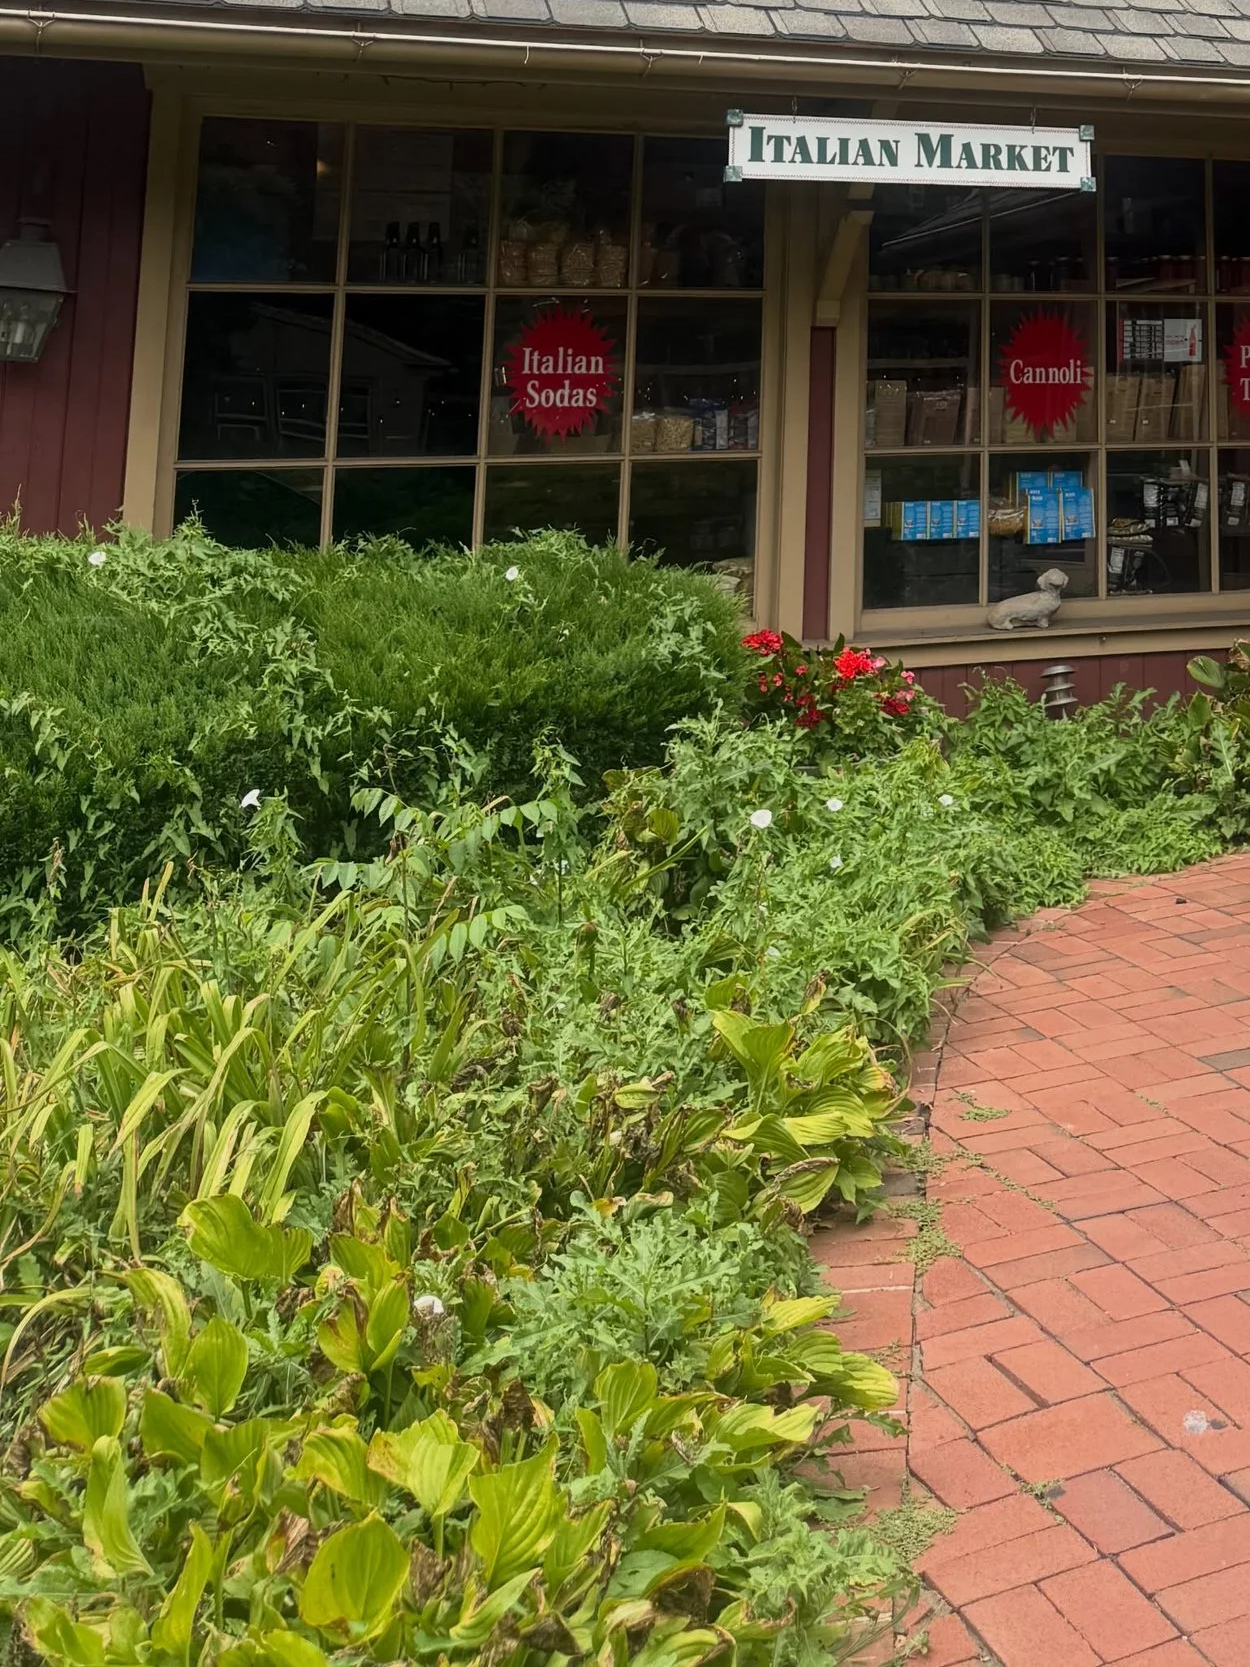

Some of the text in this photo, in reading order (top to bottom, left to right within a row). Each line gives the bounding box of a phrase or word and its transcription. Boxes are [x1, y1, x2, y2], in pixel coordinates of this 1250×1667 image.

[747, 125, 1075, 173] ITALIAN MARKET
[521, 346, 605, 375] Italian
[1009, 358, 1083, 385] Cannoli
[525, 379, 598, 408] Sodas
